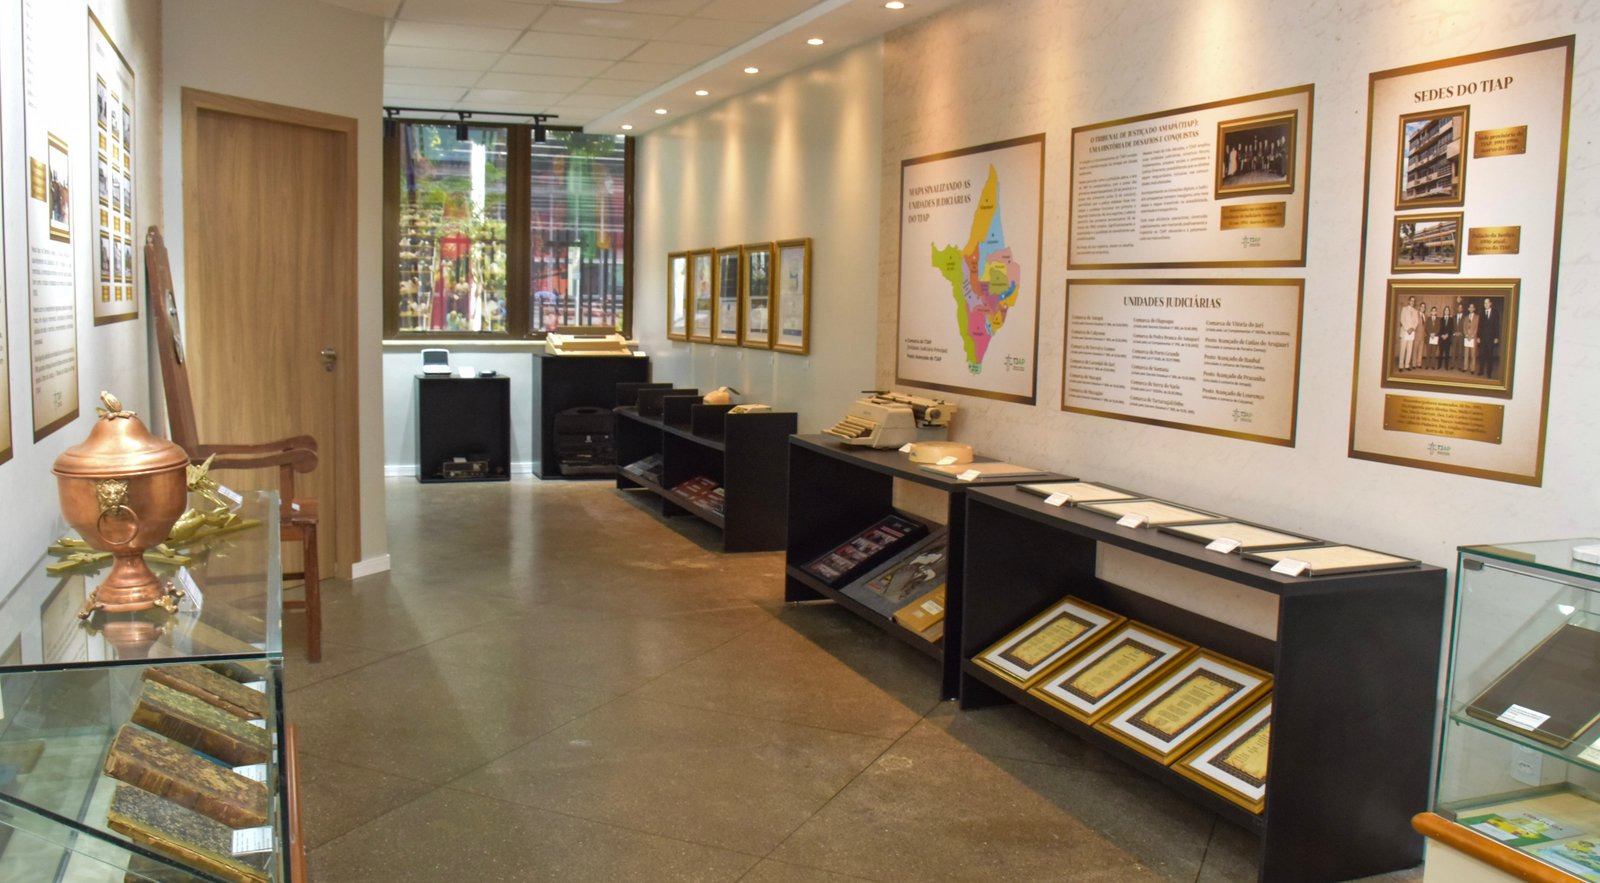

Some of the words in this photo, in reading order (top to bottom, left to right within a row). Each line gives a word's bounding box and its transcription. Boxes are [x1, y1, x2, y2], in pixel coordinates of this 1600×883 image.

[1414, 86, 1454, 103] SEDES
[1457, 82, 1477, 97] DO
[1480, 76, 1514, 93] TJAP
[1089, 145, 1101, 153] UMA
[1124, 141, 1132, 149] DE
[1133, 137, 1158, 146] DESAFIOS
[1164, 131, 1200, 143] CONQUISTAS
[1095, 134, 1119, 142] TRIBUNAL
[1128, 129, 1148, 138] JUSTIÇA
[909, 187, 924, 196] MAPA
[925, 181, 962, 194] SINALIZANDO
[964, 179, 971, 189] AS
[908, 199, 936, 210] UNIDADES
[936, 194, 971, 207] JUDICIÁRIAS
[908, 214, 916, 223] DO
[917, 213, 930, 223] TJAP
[1123, 296, 1164, 307] UNIDADES
[1165, 294, 1222, 309] JUDICIÁRIAS
